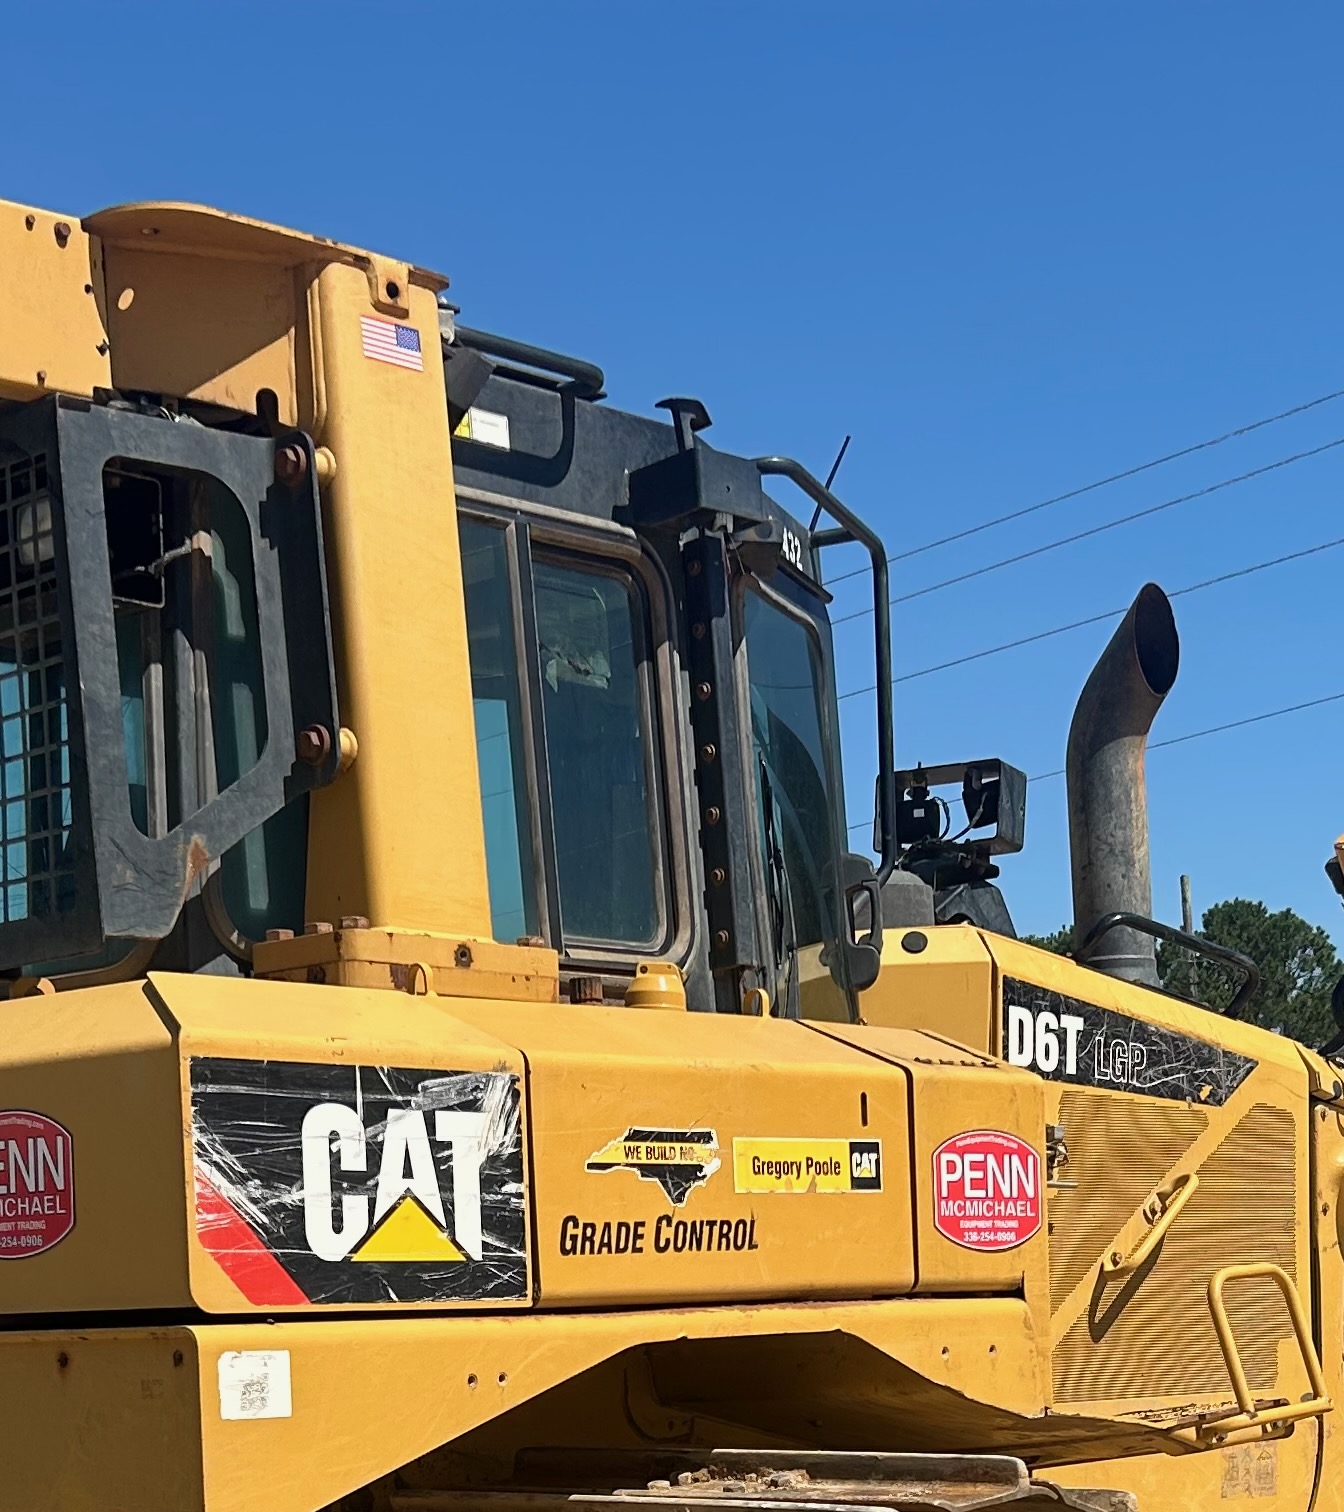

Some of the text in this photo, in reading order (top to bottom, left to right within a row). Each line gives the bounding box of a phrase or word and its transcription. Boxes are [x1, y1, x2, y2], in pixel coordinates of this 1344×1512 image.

[1008, 1005, 1147, 1084] D6T LGP
[623, 1145, 642, 1160] WE
[646, 1145, 677, 1161] BUILD
[752, 1155, 841, 1179] Gregory Poole
[851, 1152, 878, 1178] CAT
[301, 1102, 494, 1263] CAT
[940, 1152, 1036, 1199] PENN
[940, 1200, 1036, 1217] MCMICHAEL
[559, 1213, 759, 1257] GRADE CONTROL
